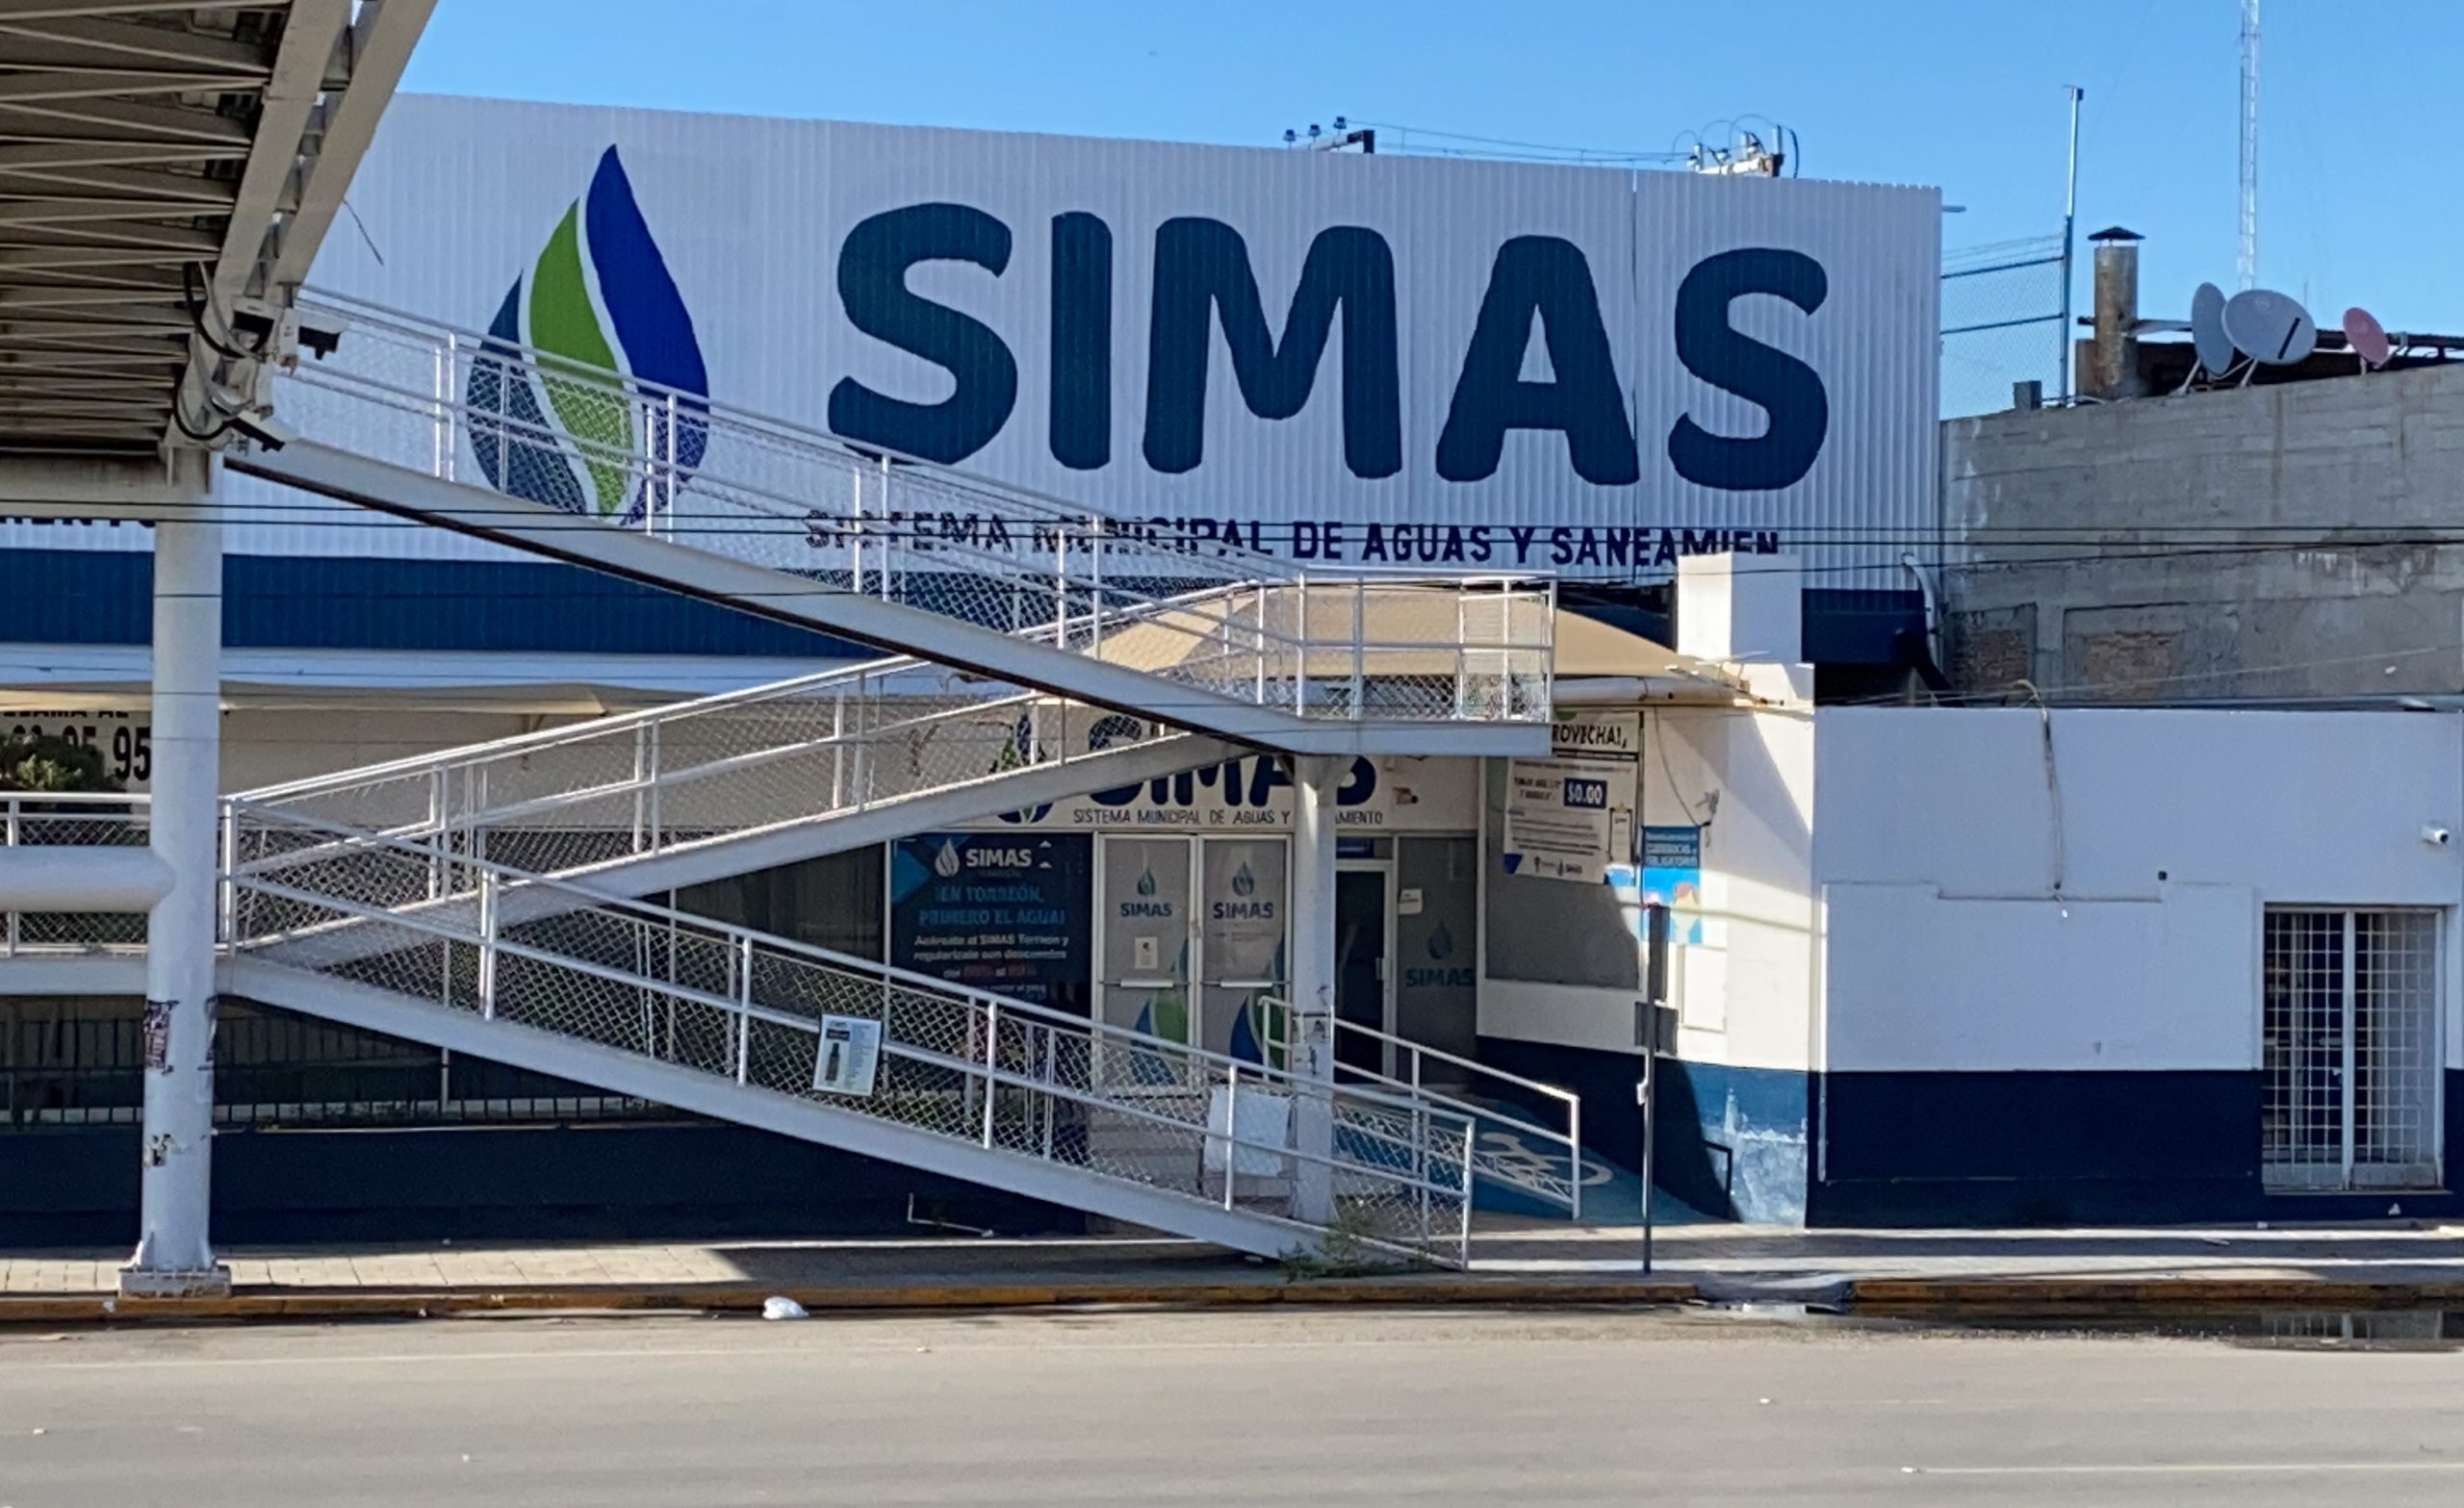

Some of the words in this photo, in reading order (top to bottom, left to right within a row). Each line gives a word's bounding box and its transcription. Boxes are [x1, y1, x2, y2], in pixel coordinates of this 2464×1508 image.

[828, 202, 1828, 492] SIMAS
[1293, 521, 1343, 560] DE
[1362, 523, 1493, 562] AGUAS
[1508, 524, 1537, 564] Y
[1567, 781, 1604, 805] $0.00
[1073, 808, 1131, 825] SISTEMA
[1137, 808, 1201, 825] MUNICIPAL
[1209, 809, 1224, 825] DE
[1233, 809, 1275, 825] AGUAS
[1280, 809, 1291, 825] Y
[965, 848, 1033, 868] SIMAS
[994, 909, 1014, 925] EL
[1120, 902, 1173, 918] SIMAS
[1212, 901, 1274, 920] SIMAS
[1405, 967, 1476, 987] SIMAS
